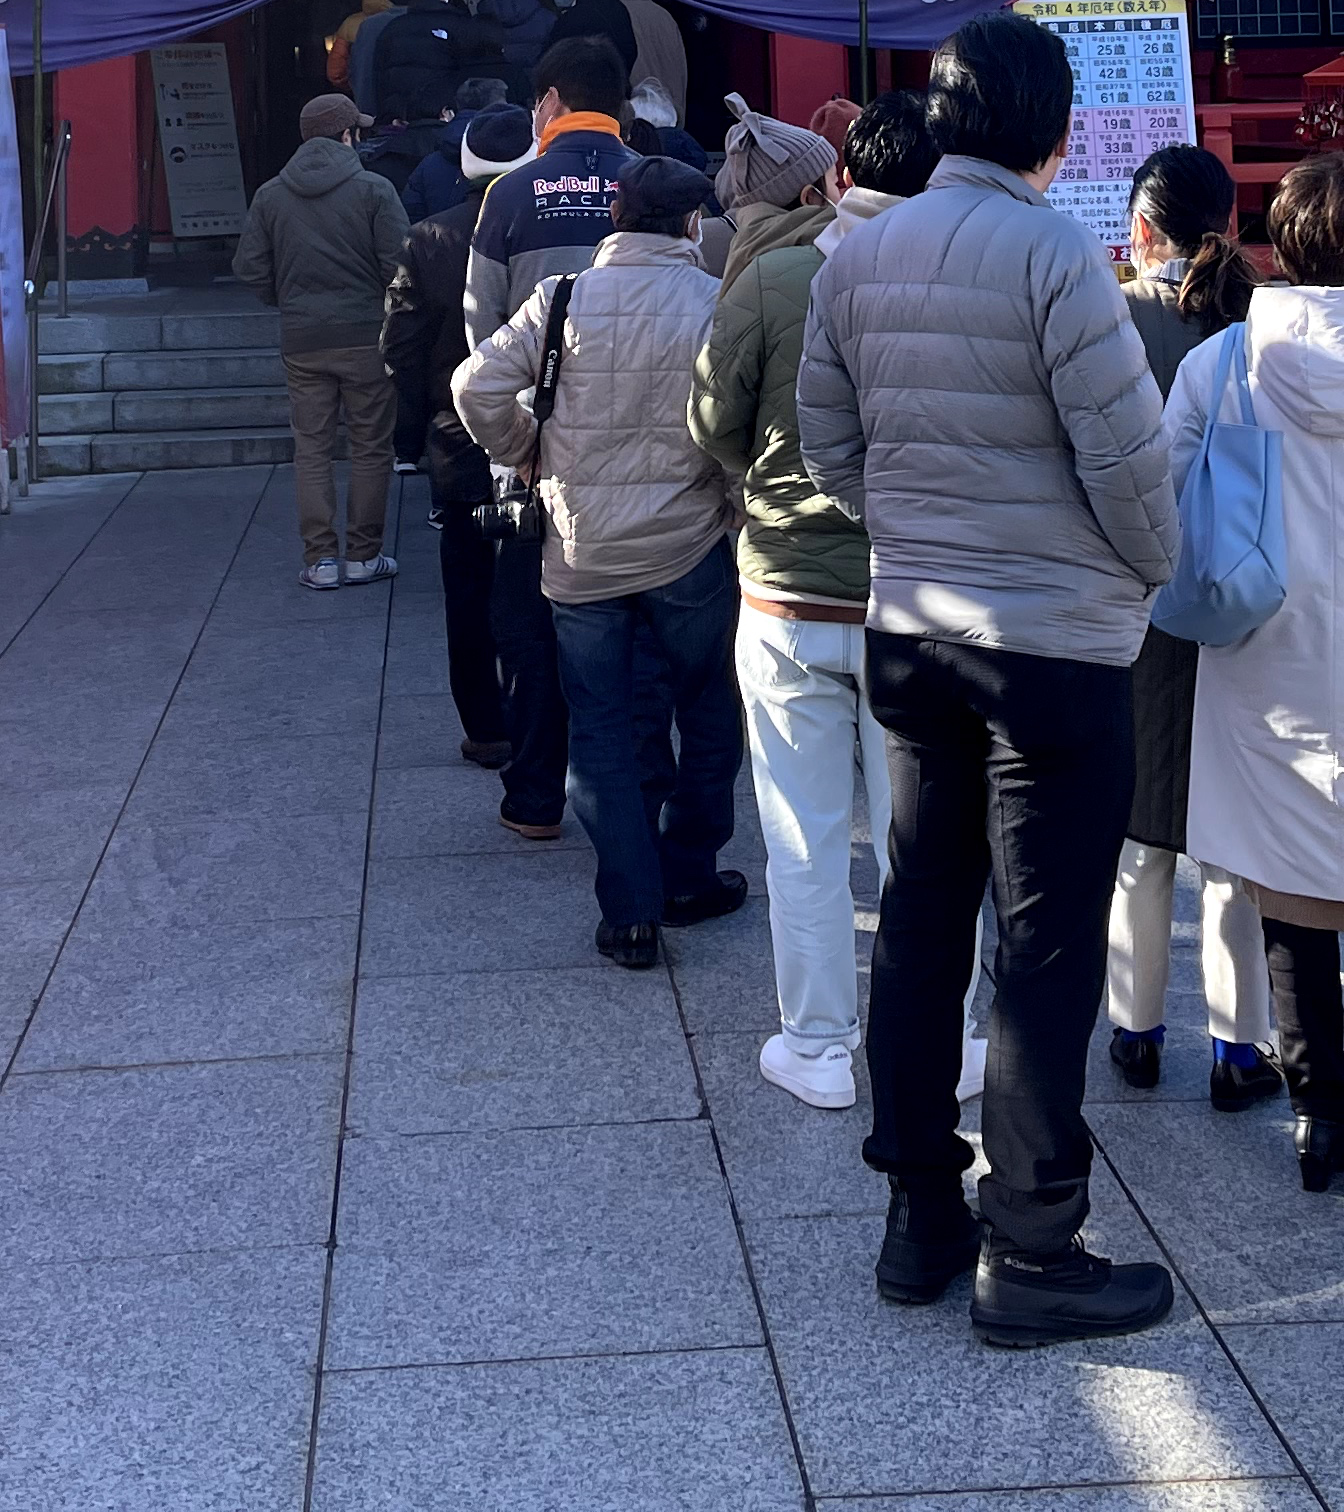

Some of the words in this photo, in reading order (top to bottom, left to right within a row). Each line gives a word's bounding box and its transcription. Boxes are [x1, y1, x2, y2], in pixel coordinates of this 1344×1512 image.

[1032, 0, 1167, 16] 令和4年厄年(数え年)
[1093, 20, 1126, 31] 本厄
[1097, 44, 1127, 56] 25歳
[1144, 42, 1174, 54] 26歳
[1099, 68, 1128, 80] 42歳
[1145, 66, 1174, 78] 43歳
[1100, 91, 1130, 104] 61歳
[1147, 89, 1177, 102] 62歳
[1103, 118, 1132, 130] 19歳
[1149, 116, 1179, 129] 20歳
[1104, 141, 1134, 154] 33歳
[1059, 168, 1089, 180] 36歳
[536, 194, 608, 208] RACI
[542, 349, 559, 389] Canon
